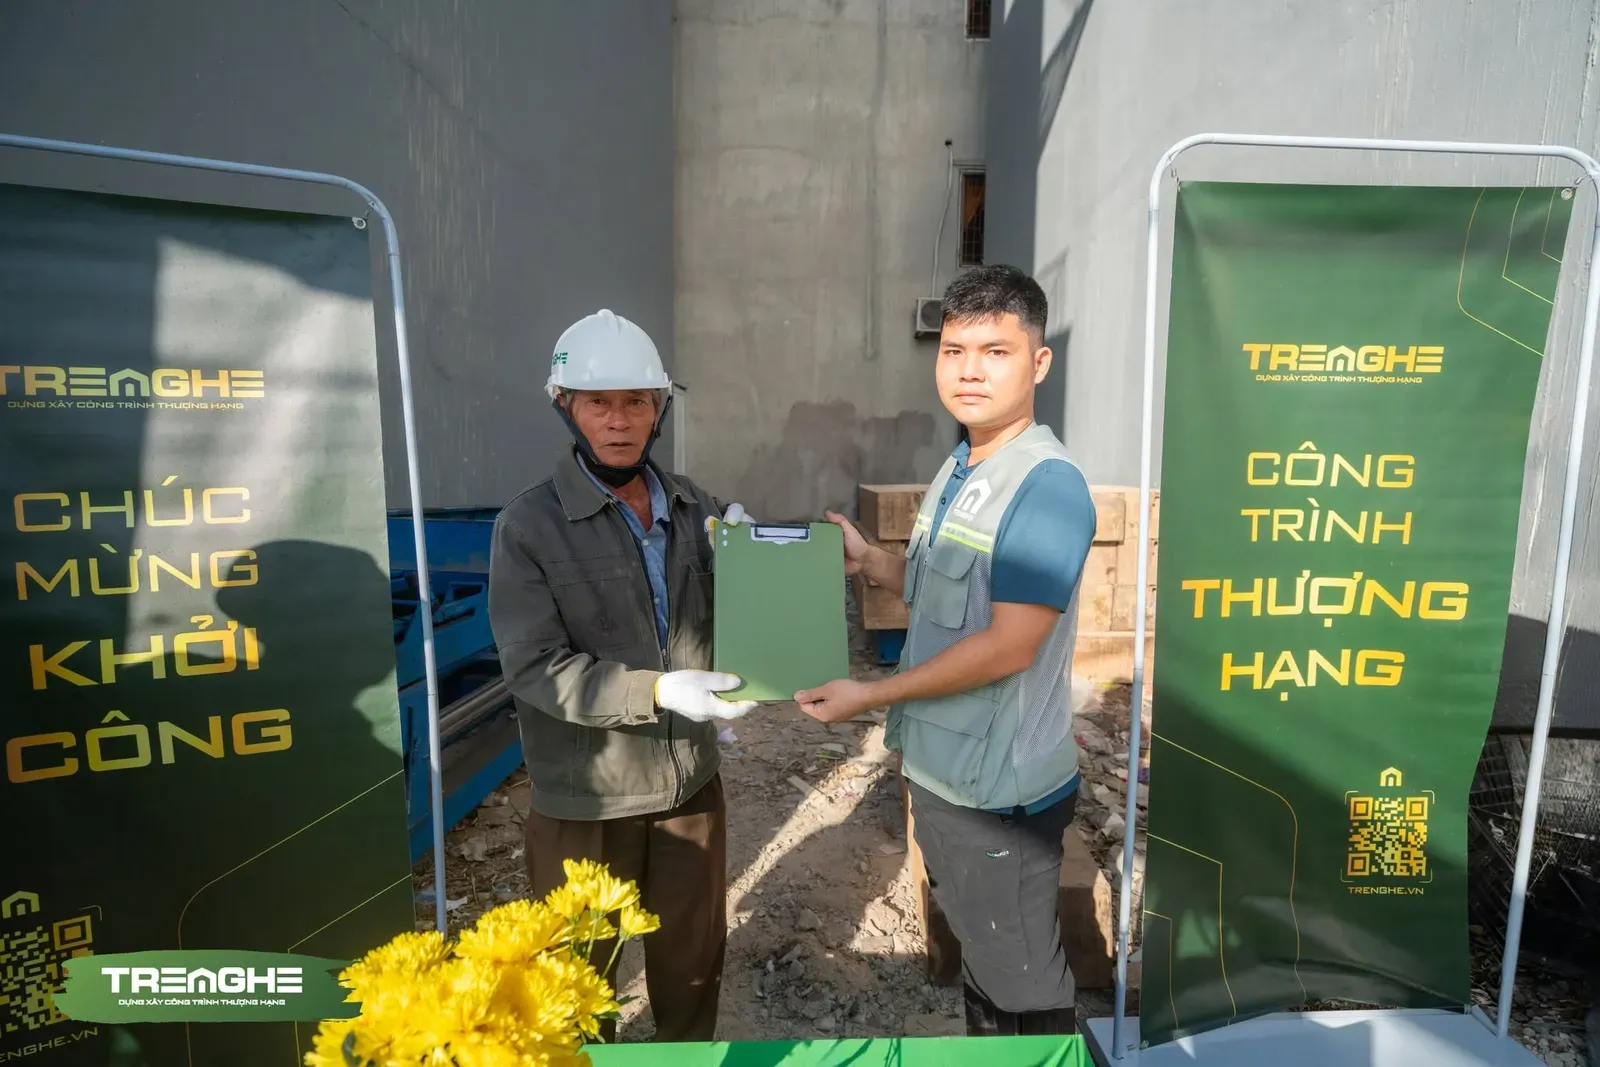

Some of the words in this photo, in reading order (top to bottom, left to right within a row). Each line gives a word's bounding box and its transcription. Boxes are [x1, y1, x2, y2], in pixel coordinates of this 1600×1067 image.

[48, 400, 74, 409] XÂY
[76, 400, 115, 409] CÔNG
[117, 400, 155, 409] TRÌNH
[1282, 374, 1301, 382] XÂY
[1301, 374, 1328, 383] CÔNG
[1328, 374, 1357, 383] TRÌNH
[1247, 441, 1415, 488] CÔNG
[13, 475, 250, 532] CHÚC
[1240, 497, 1413, 545] TRÌNH
[15, 543, 259, 601] MỪNG
[1181, 570, 1469, 627] THƯỢNG
[29, 614, 260, 690] KHỞI
[1220, 648, 1405, 701] HẠNG
[5, 708, 293, 784] CÔNG
[1347, 886, 1424, 895] TRENGHE.VN
